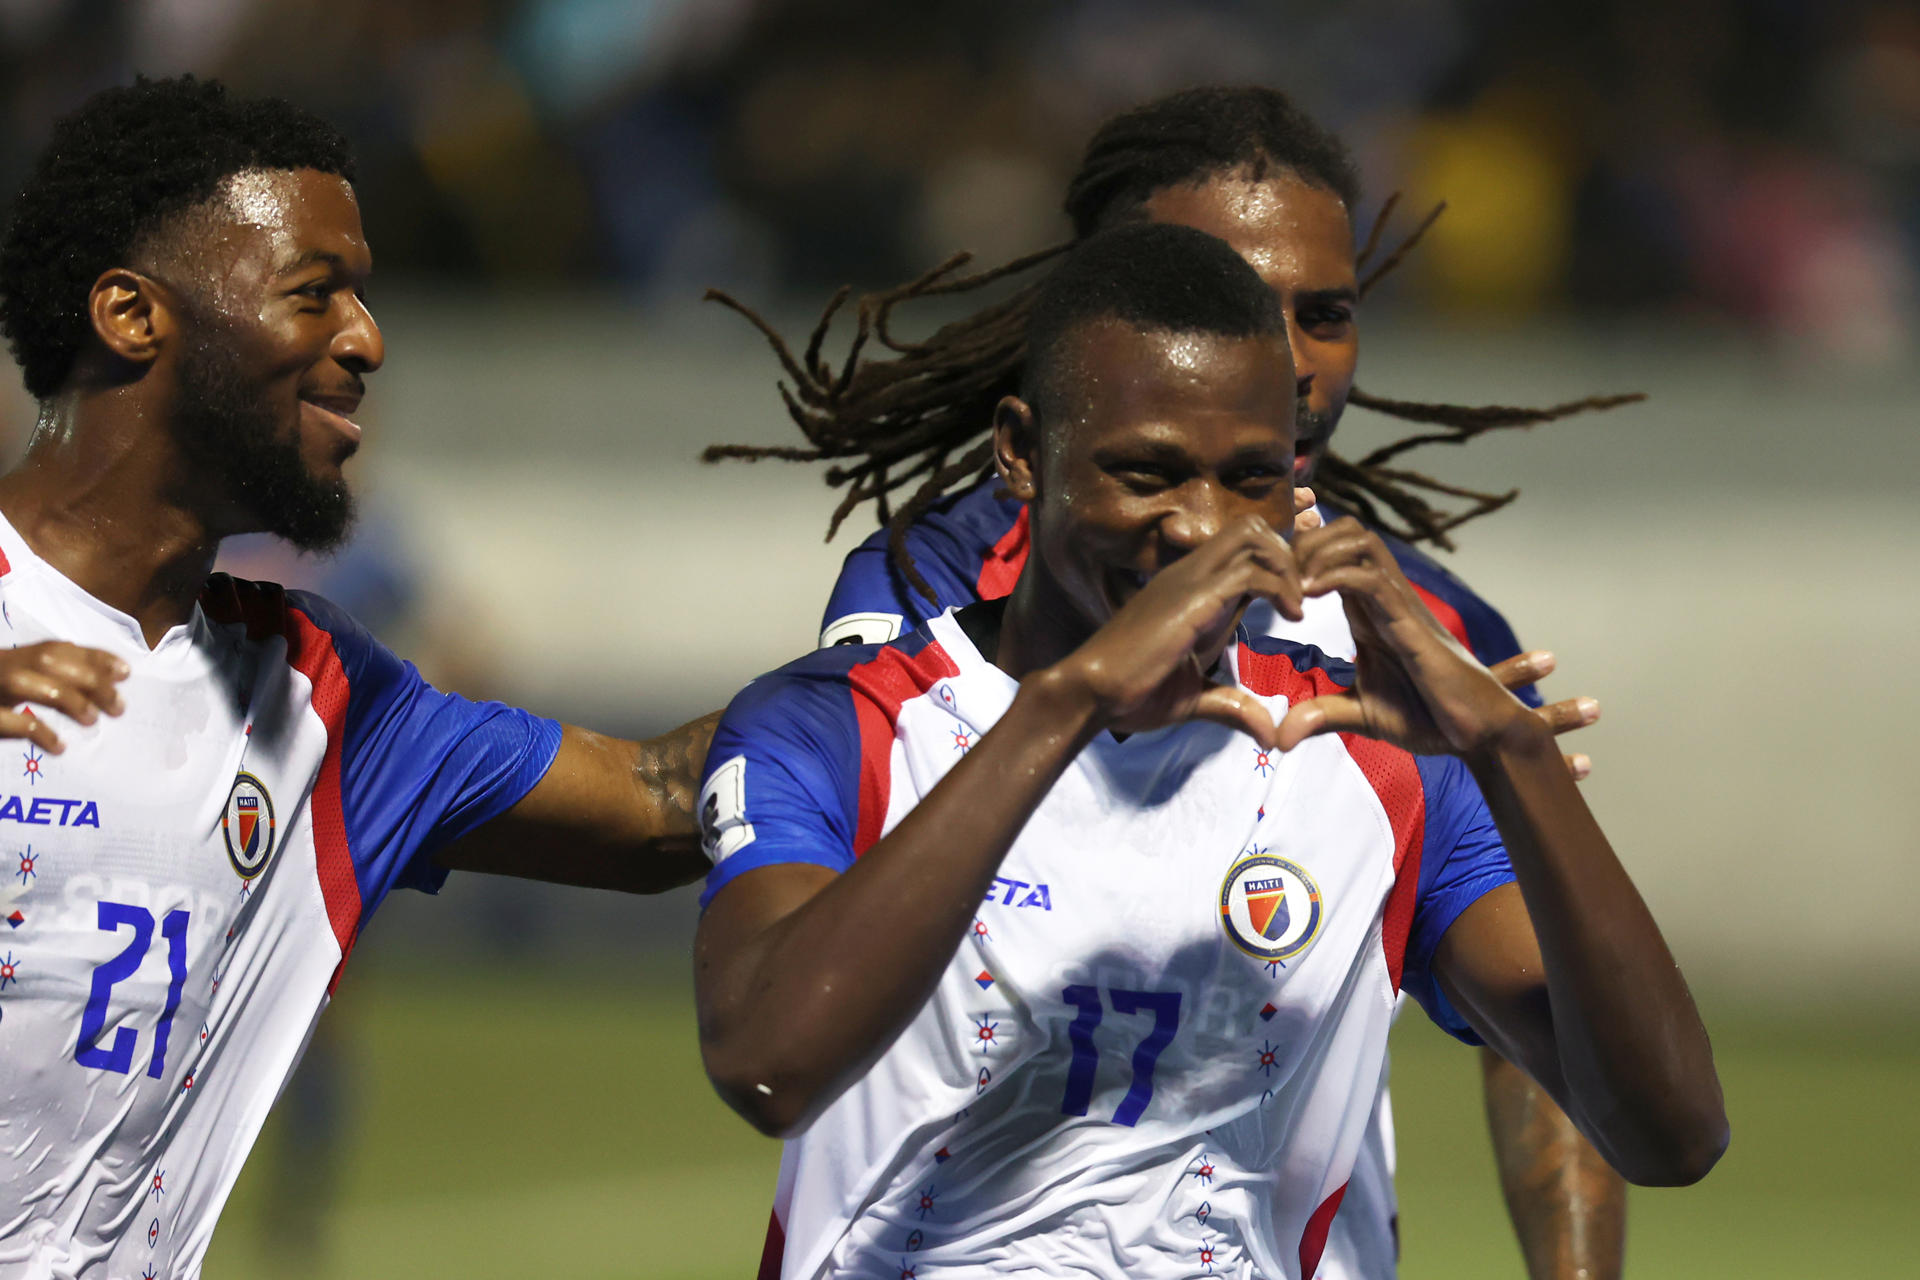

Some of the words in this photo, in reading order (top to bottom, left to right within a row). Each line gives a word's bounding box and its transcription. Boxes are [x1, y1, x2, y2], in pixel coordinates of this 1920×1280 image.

[0, 795, 100, 829] AETA
[239, 798, 257, 807] HAITI
[1248, 879, 1279, 891] HAITI
[74, 901, 191, 1080] 21
[1061, 984, 1183, 1128] 17
